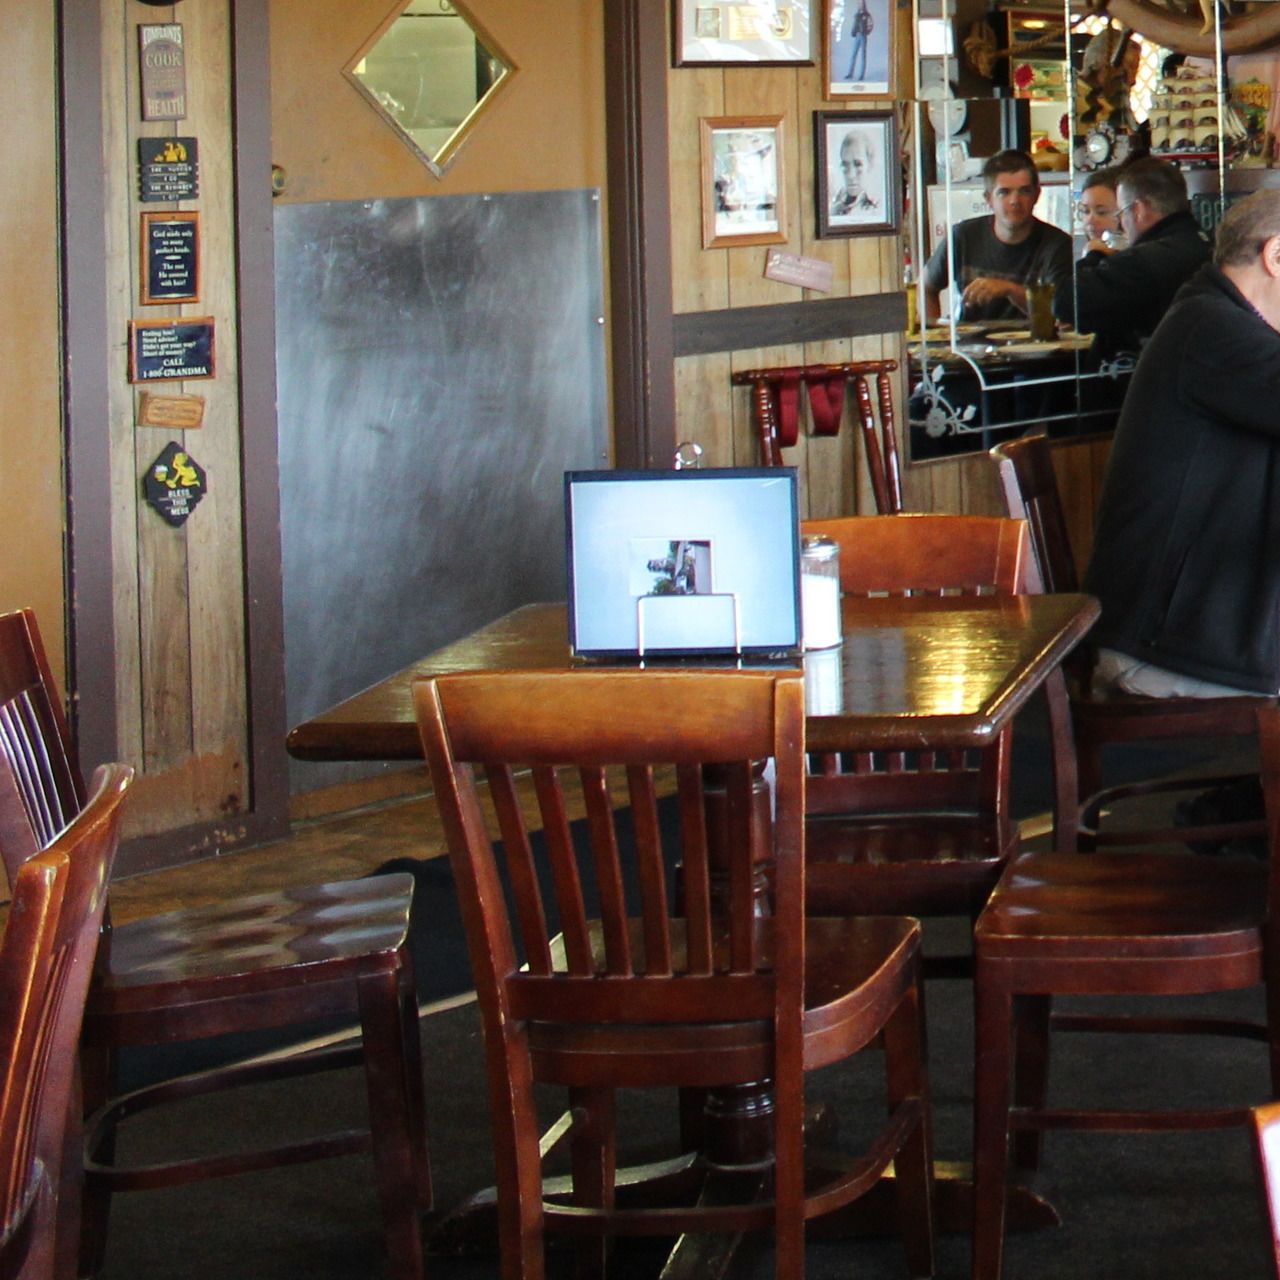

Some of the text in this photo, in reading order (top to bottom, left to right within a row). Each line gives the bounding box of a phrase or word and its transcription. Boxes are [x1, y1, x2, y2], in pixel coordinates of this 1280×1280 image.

[145, 53, 181, 68] COOK
[168, 489, 190, 498] BLESS
[172, 498, 187, 506] THIS
[170, 507, 189, 515] MESS
